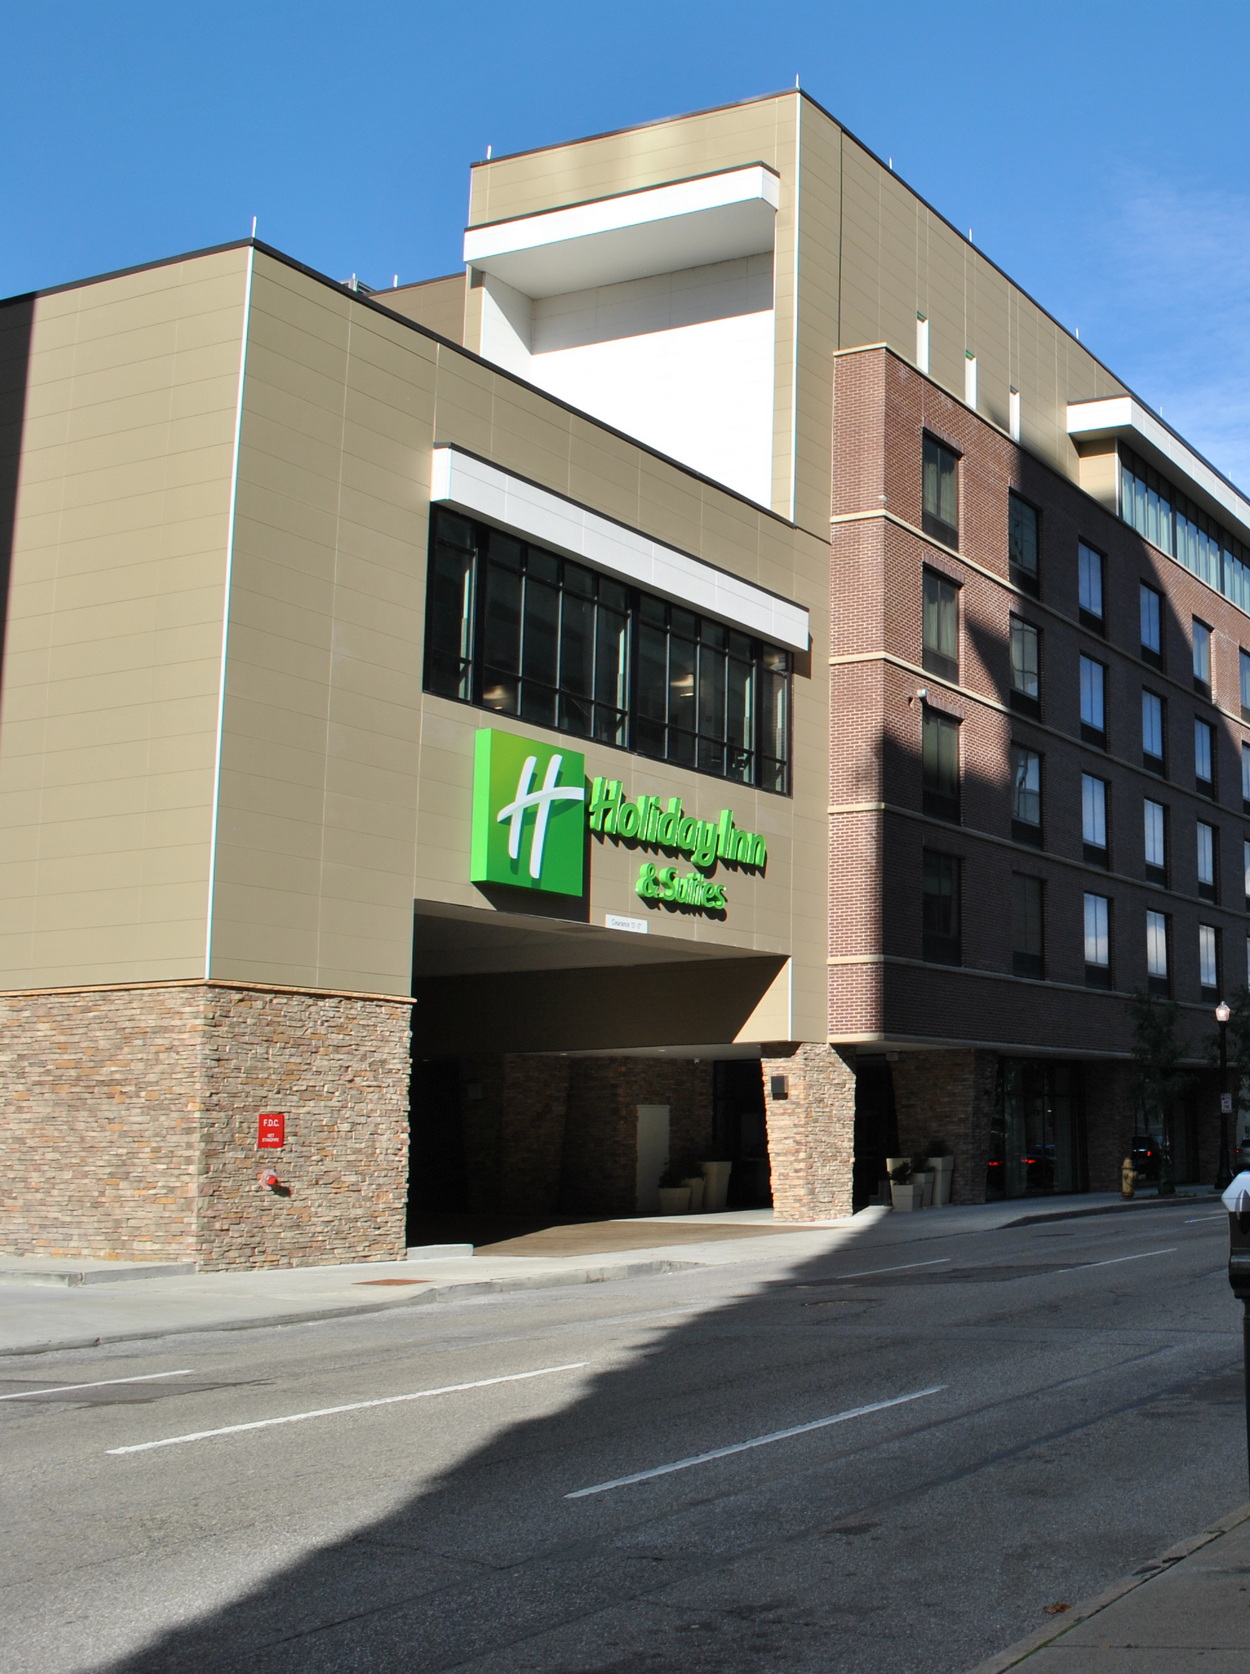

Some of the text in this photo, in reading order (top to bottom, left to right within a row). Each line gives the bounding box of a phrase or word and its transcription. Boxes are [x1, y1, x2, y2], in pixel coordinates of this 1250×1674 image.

[589, 777, 767, 868] Holiday Inn
[636, 863, 727, 910] & Suites
[263, 1119, 280, 1127] F.D.C.
